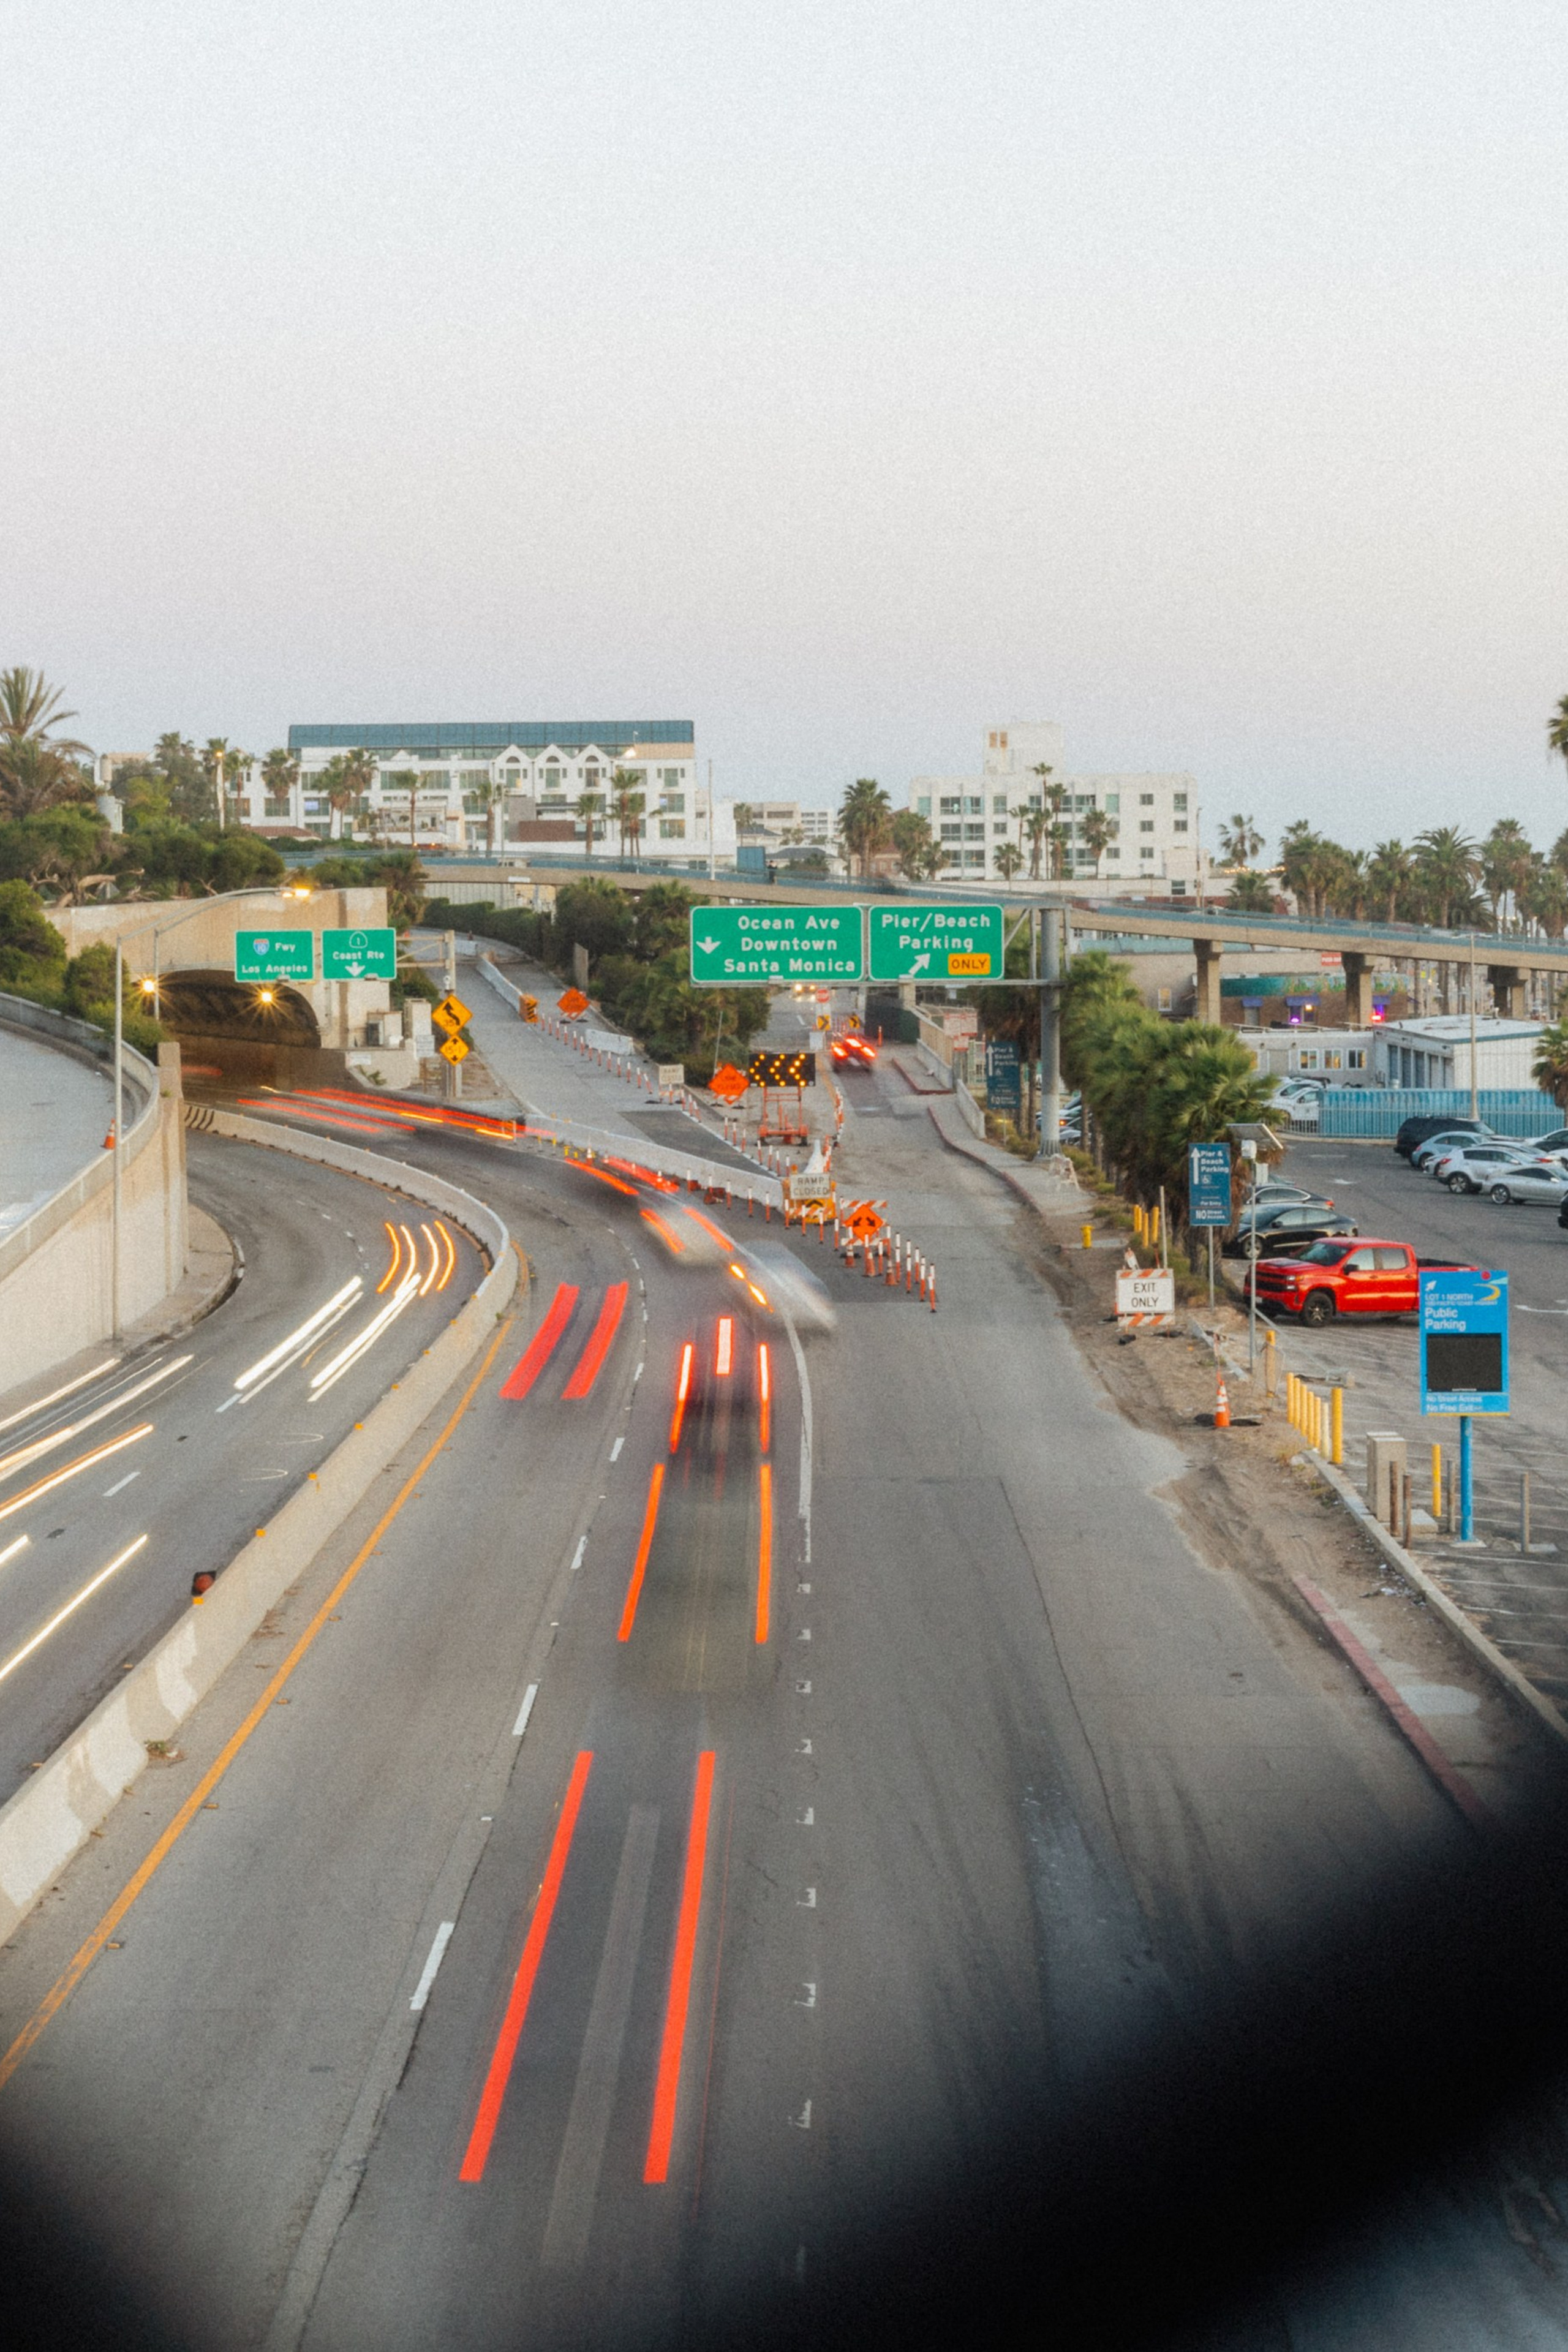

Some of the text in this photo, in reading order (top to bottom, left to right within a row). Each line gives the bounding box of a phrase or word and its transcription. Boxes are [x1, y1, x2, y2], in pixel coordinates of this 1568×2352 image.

[737, 915, 840, 930] Ocean Ave
[881, 913, 990, 933] Pier/Beach
[356, 937, 361, 946] 1
[741, 937, 837, 951] Downtown
[899, 935, 973, 953] Parking
[274, 942, 296, 953] Fwy
[333, 951, 385, 960] Coast Rte
[241, 963, 307, 975] Los Angeles
[723, 958, 855, 973] Santa Monica
[951, 959, 987, 970] ONLY
[797, 1177, 824, 1185] RAMP
[793, 1186, 829, 1196] CLOSED
[1196, 1210, 1207, 1219] NO
[1134, 1283, 1157, 1293] EXIT
[1131, 1297, 1159, 1308] ONLY
[1425, 1306, 1458, 1318] Public
[1425, 1318, 1466, 1332] Parking
[1426, 1403, 1438, 1412] No
